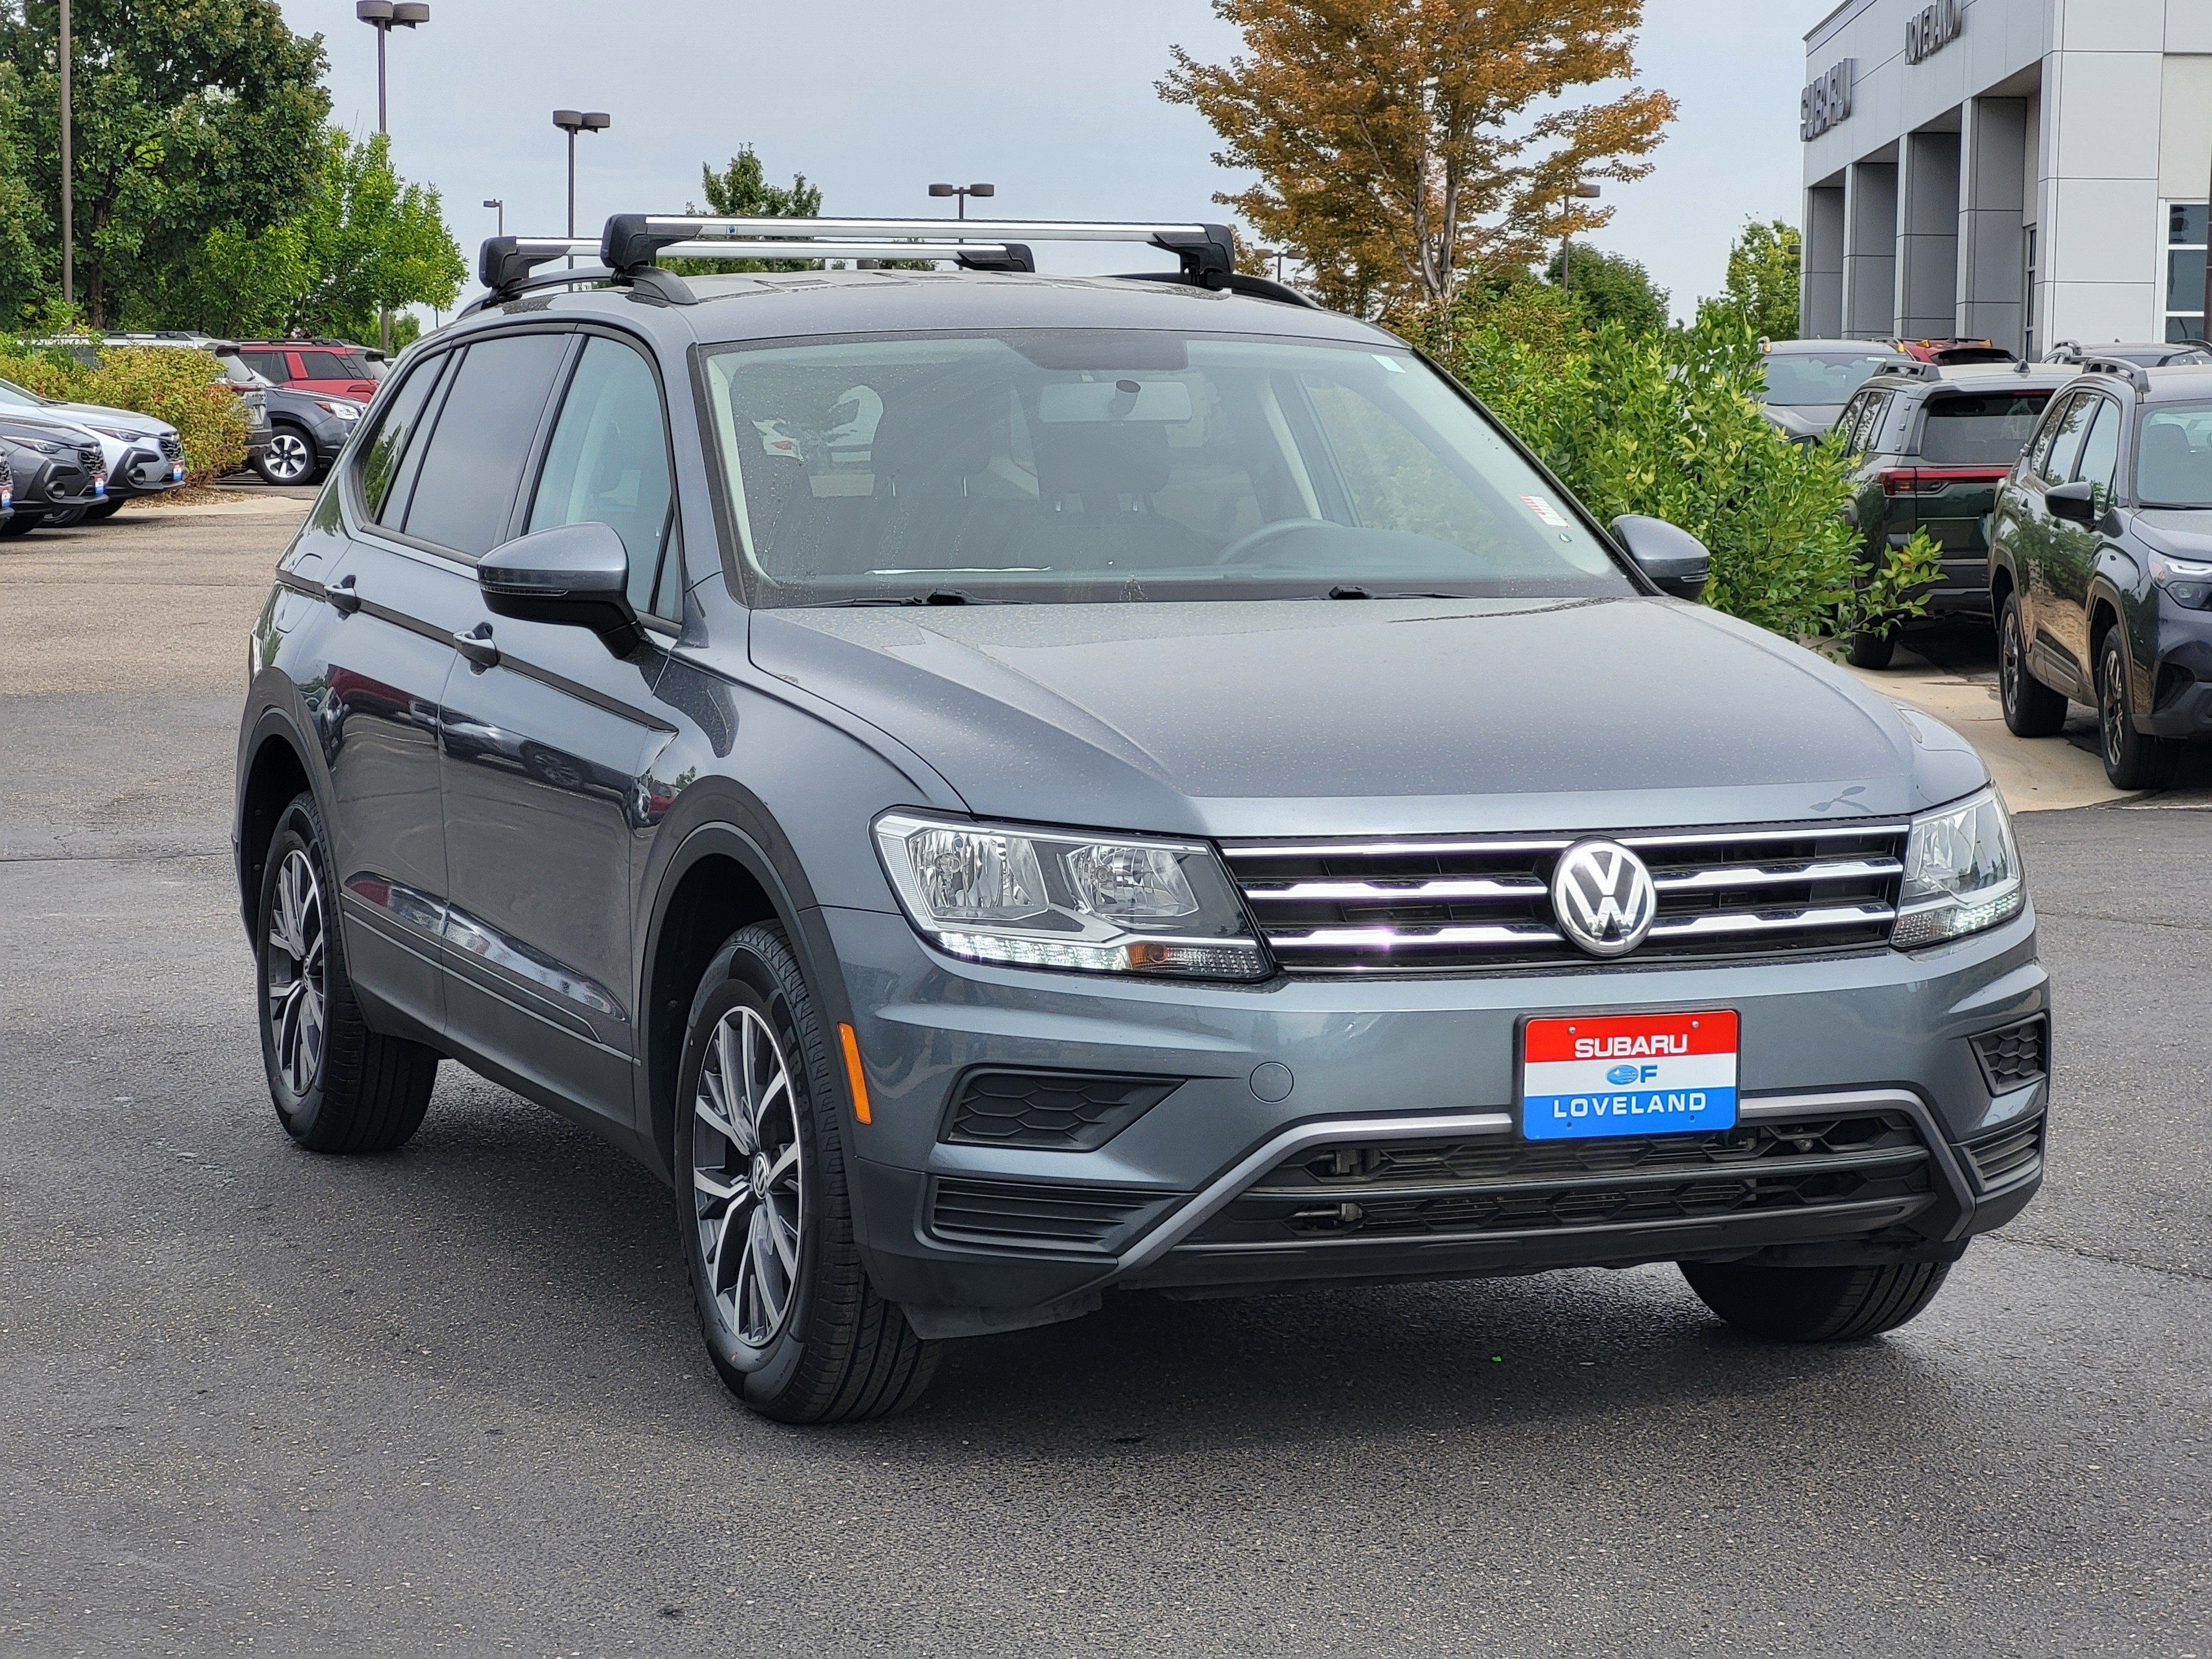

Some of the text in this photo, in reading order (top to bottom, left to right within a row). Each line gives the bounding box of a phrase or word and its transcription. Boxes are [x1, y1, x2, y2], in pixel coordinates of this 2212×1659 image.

[1800, 58, 1852, 142] SUBARU
[1556, 841, 1655, 947] VW
[1575, 1034, 1687, 1057] SUBARU
[1553, 1093, 1706, 1118] LOVELAND
